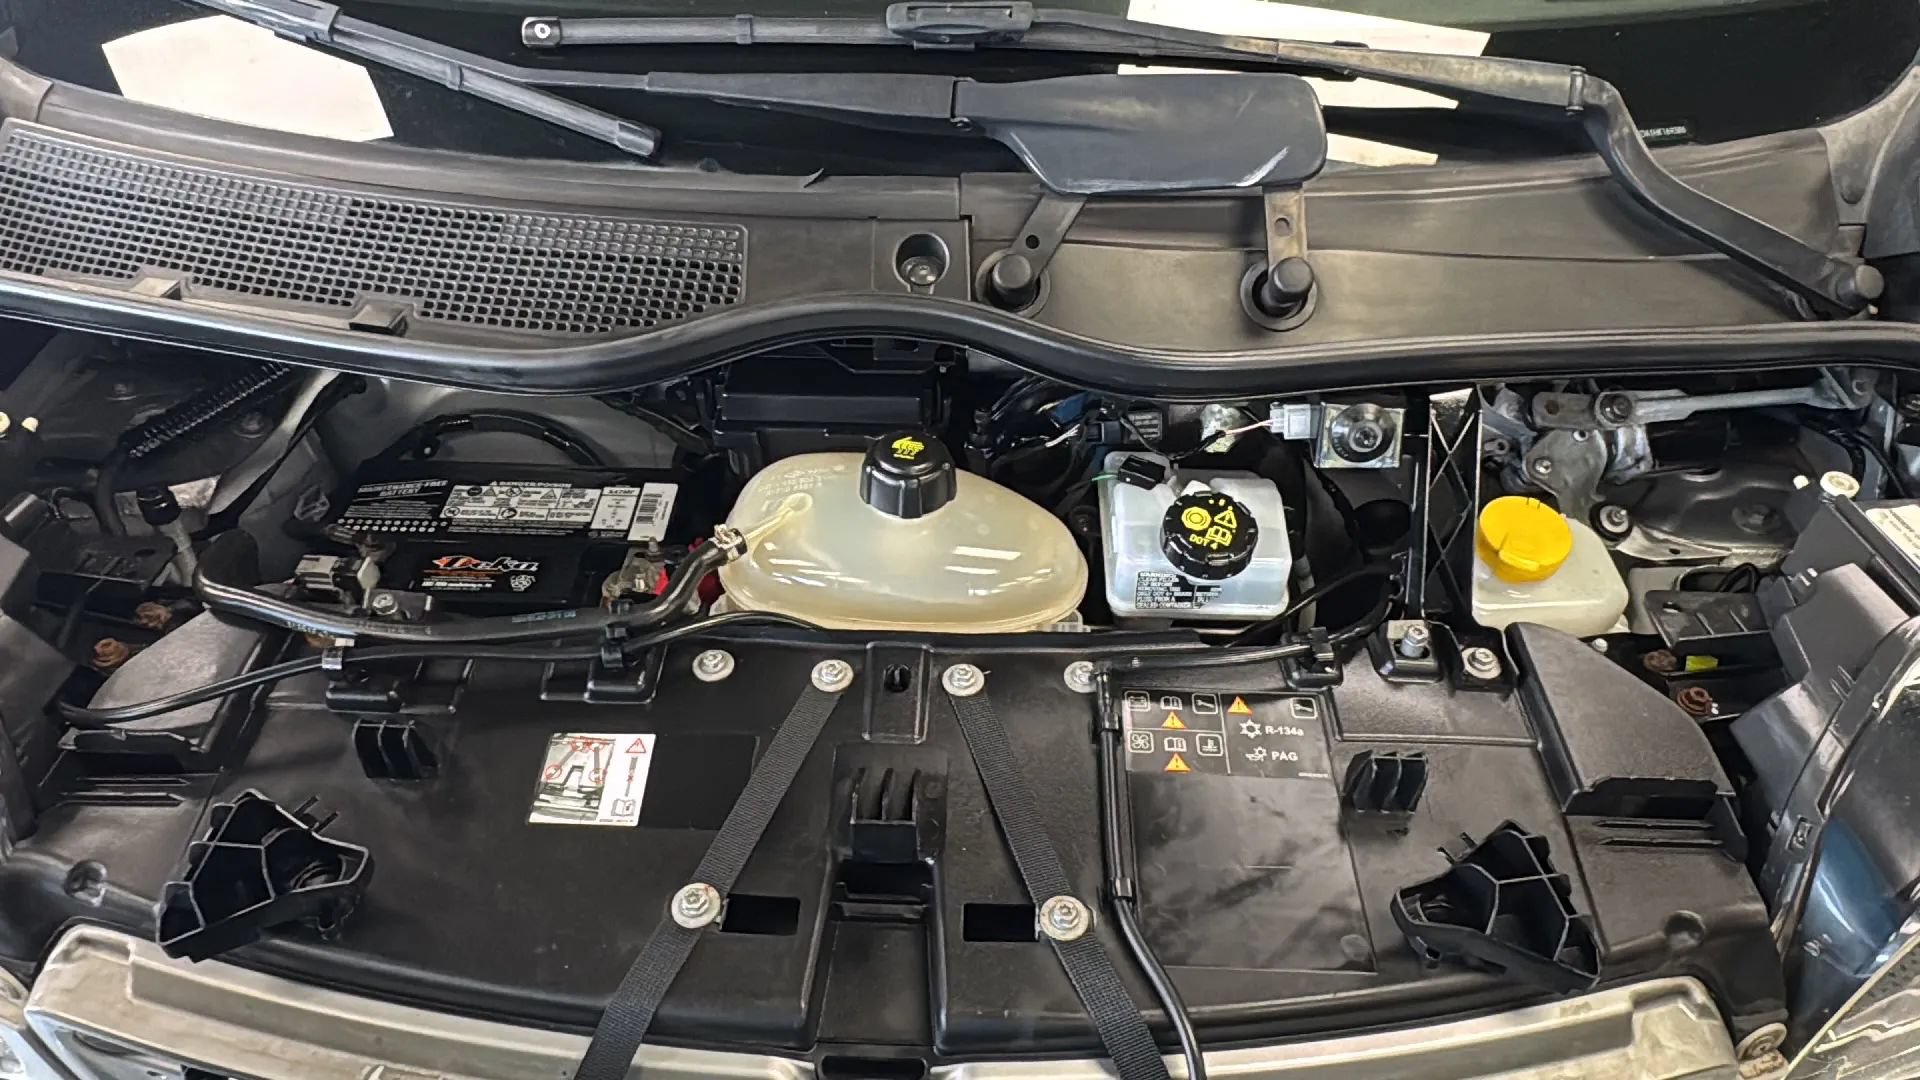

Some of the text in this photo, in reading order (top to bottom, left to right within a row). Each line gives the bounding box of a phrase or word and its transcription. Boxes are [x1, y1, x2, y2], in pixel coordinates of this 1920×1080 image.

[1189, 533, 1218, 550] DOT 4
[432, 555, 540, 572] Deka
[1265, 725, 1304, 736] R-134a
[1272, 752, 1298, 761] PAG
